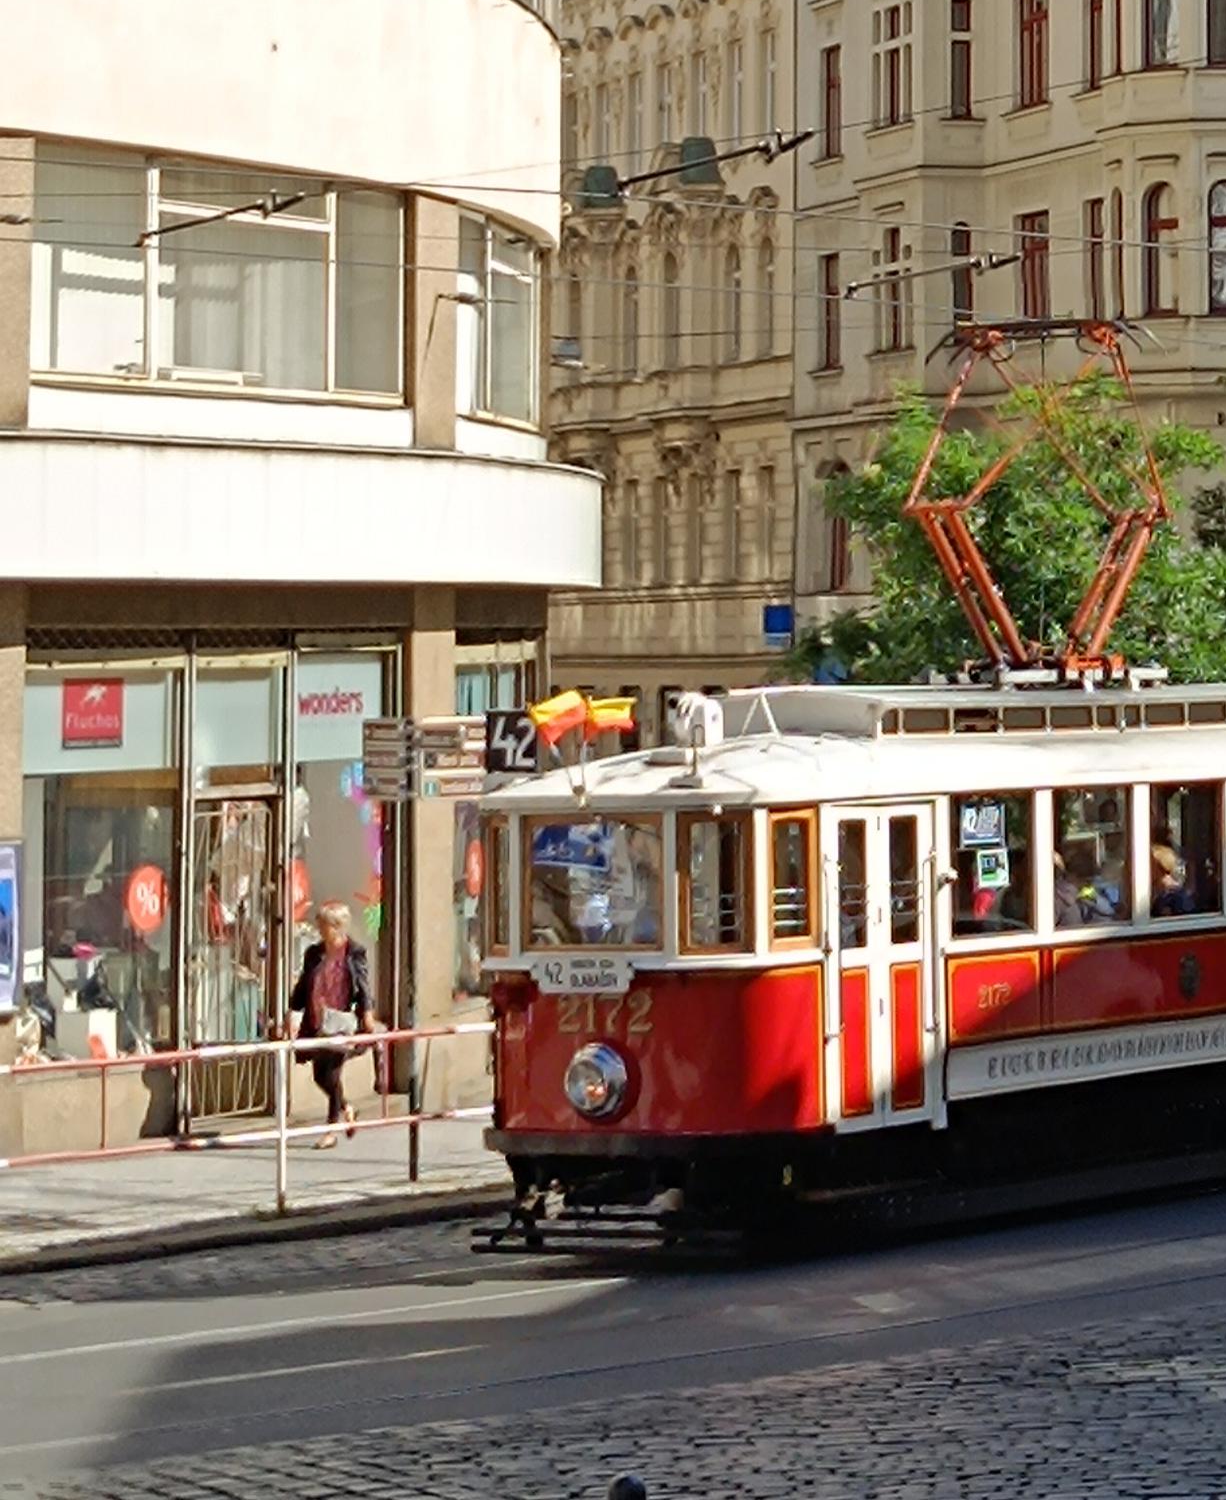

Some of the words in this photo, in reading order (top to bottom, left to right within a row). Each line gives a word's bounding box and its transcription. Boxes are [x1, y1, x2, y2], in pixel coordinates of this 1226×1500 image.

[298, 687, 363, 715] wonders
[490, 716, 536, 769] 42
[543, 962, 563, 985] 42
[558, 990, 654, 1035] 2172
